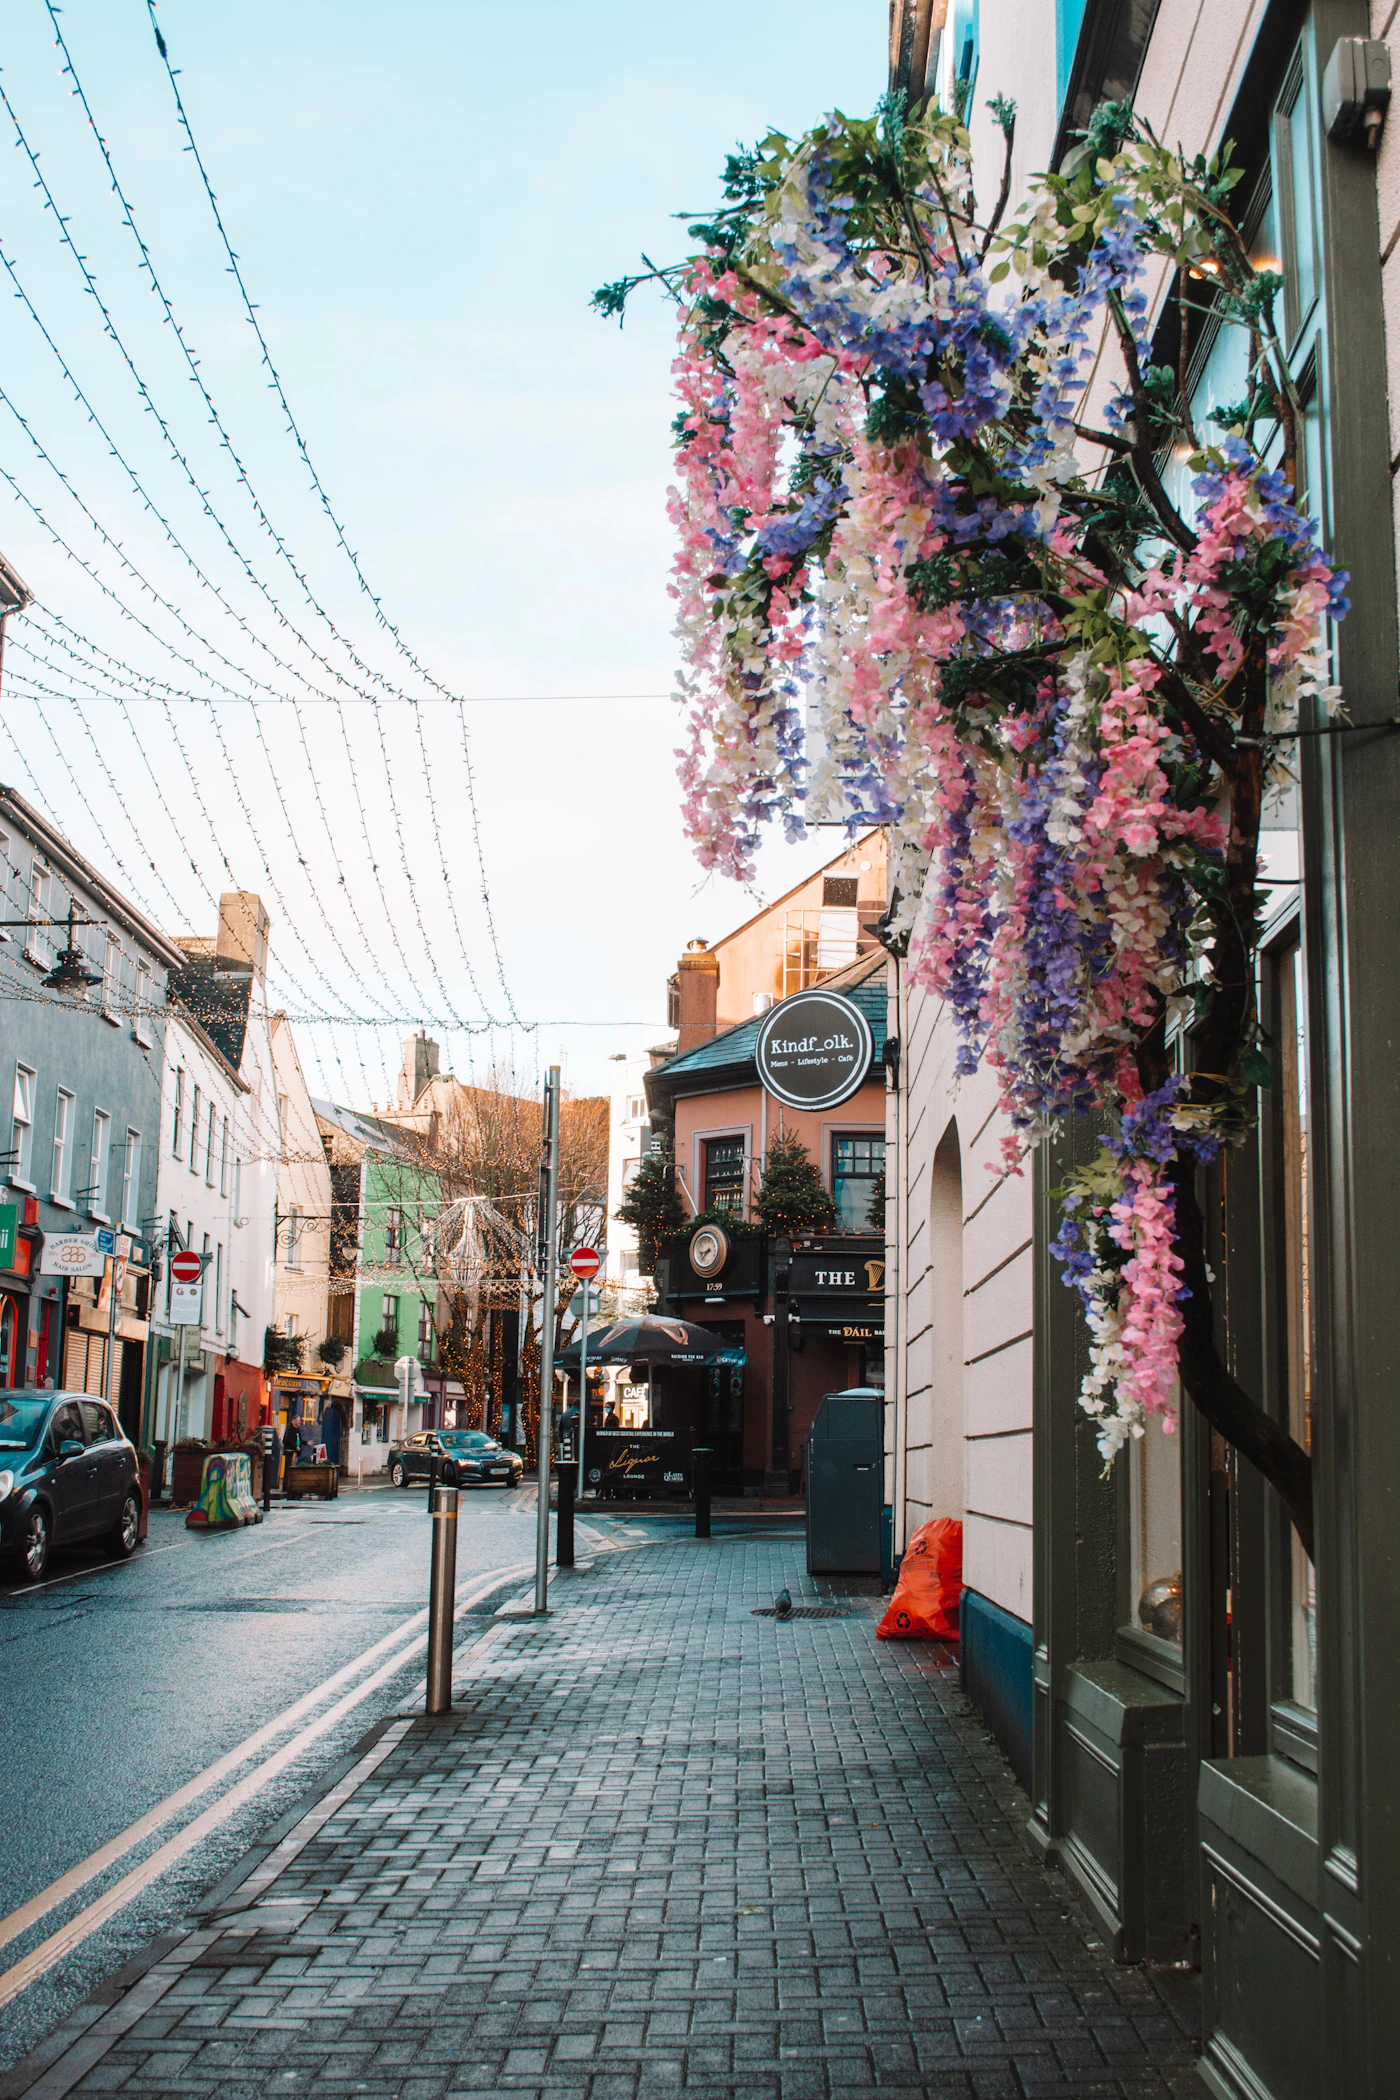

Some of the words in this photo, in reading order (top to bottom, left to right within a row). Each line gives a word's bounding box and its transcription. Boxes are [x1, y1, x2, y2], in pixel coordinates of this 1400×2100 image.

[770, 1034, 854, 1054] Kindf_olk.
[798, 1056, 828, 1066] Lifestyle
[50, 1238, 78, 1250] BARBER
[53, 1262, 69, 1272] HAIR
[71, 1262, 92, 1272] SALON
[815, 1272, 855, 1286] THE
[843, 1326, 872, 1336] DÁIL
[609, 1448, 660, 1474] Liquor
